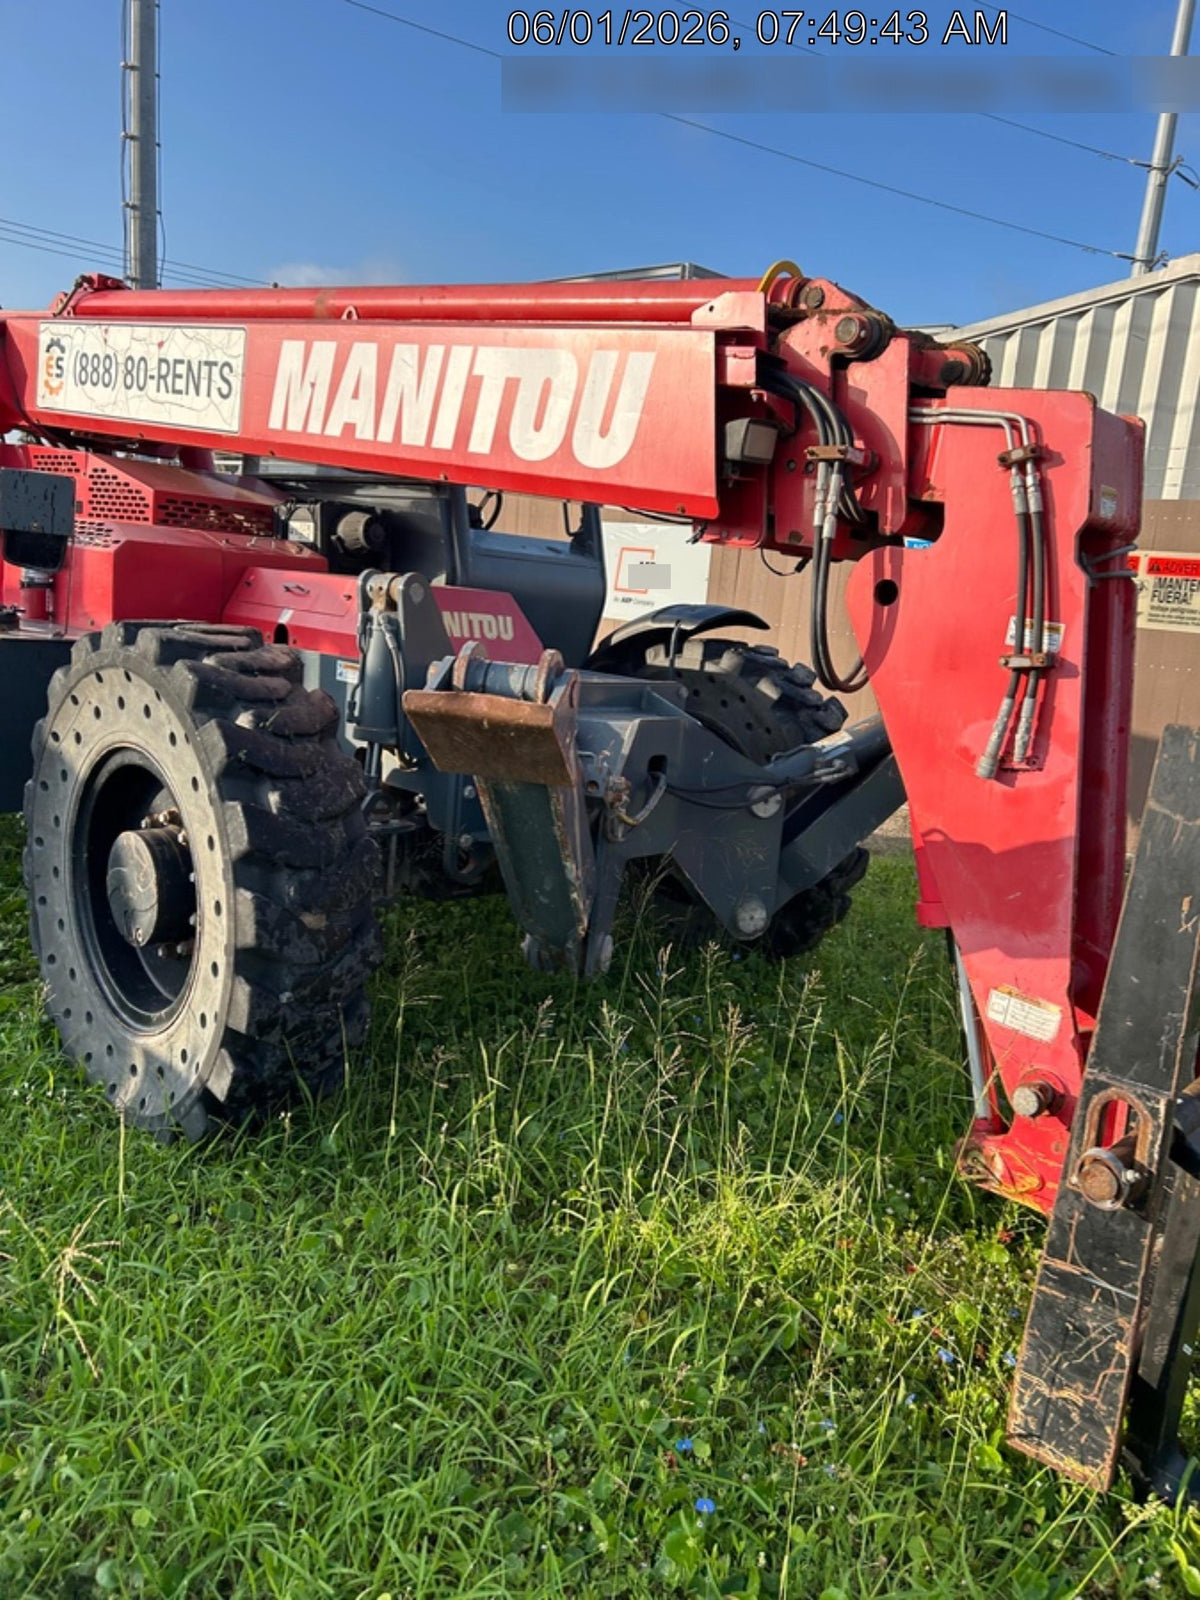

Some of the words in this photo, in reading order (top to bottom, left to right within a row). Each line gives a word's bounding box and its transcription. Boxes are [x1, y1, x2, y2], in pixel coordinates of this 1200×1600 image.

[73, 349, 119, 391] (888)
[123, 354, 235, 400] 80-RENTS
[267, 339, 658, 470] MANITOU
[441, 610, 515, 641] NITOU
